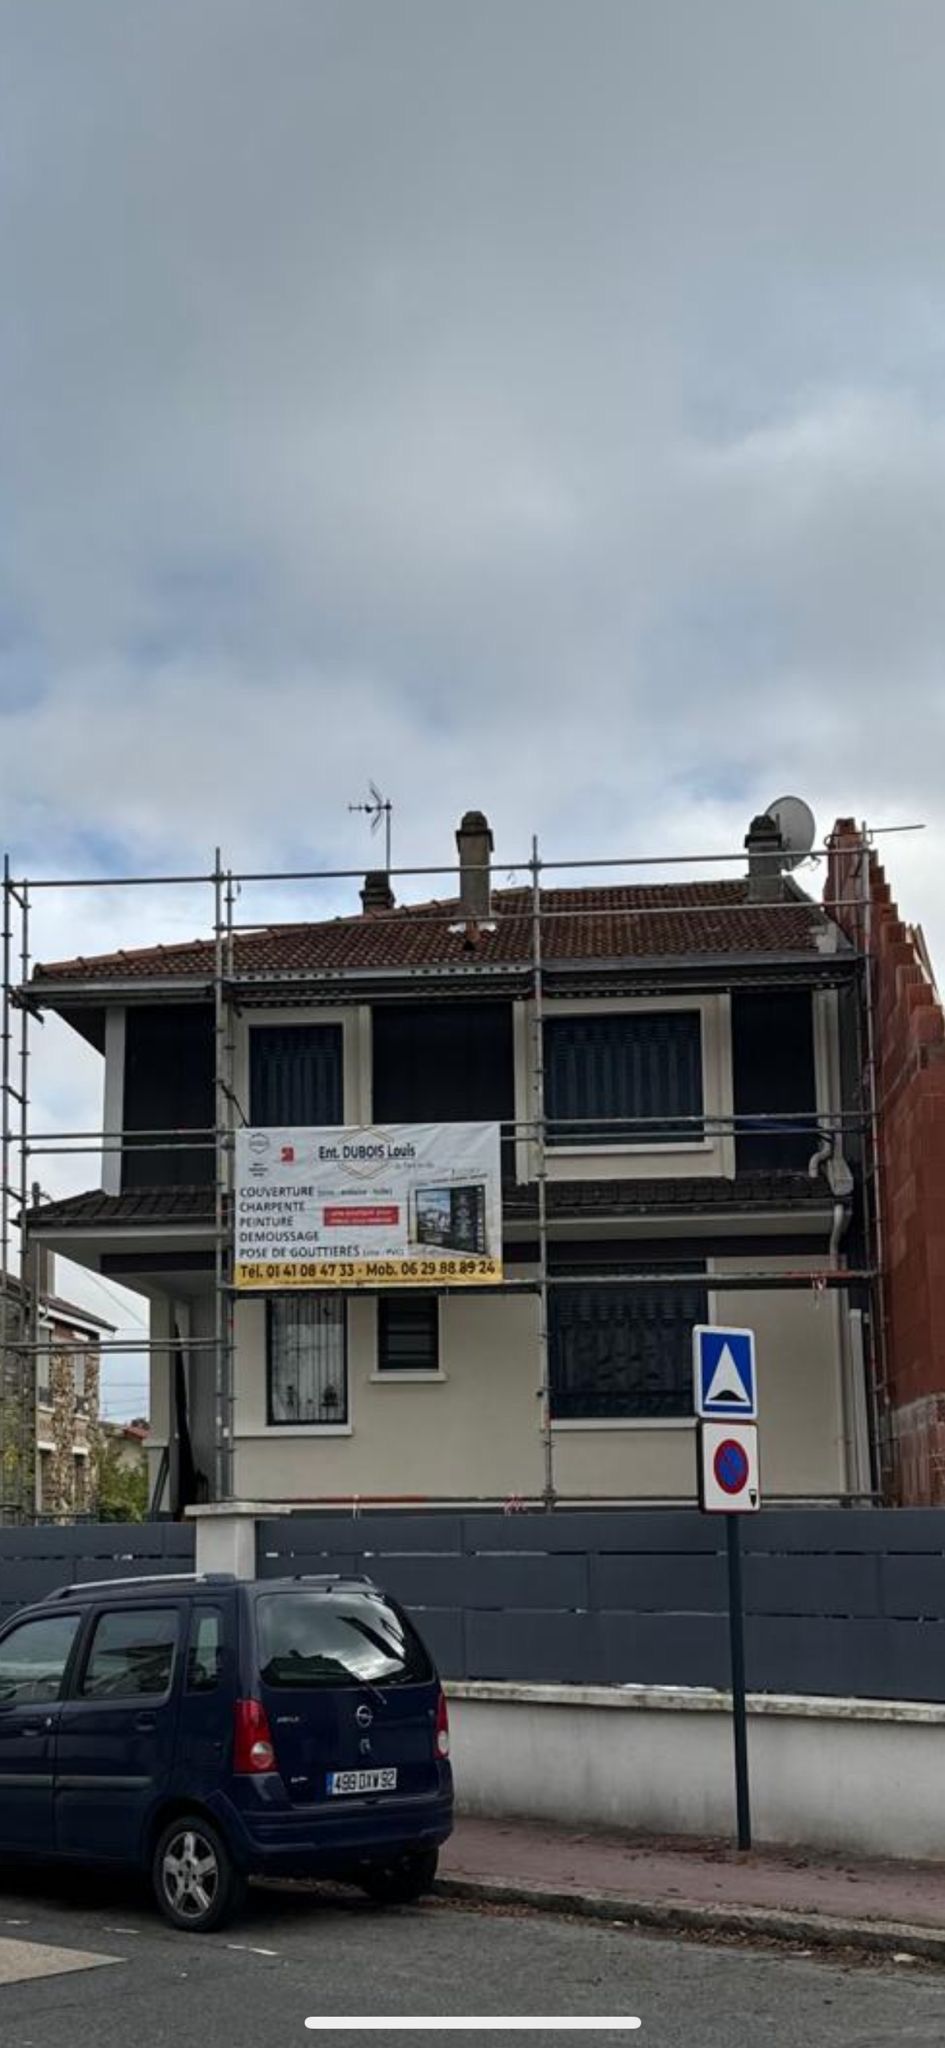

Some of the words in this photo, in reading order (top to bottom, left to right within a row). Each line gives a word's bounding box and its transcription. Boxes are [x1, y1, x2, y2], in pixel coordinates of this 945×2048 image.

[318, 1146, 340, 1159] Ent.
[343, 1144, 385, 1158] DUBOIS
[388, 1142, 416, 1157] Louis
[240, 1186, 314, 1198] COUVERTURE
[240, 1201, 305, 1213] CHARPENTE
[240, 1216, 294, 1227] PEINTURE
[239, 1231, 319, 1242] DEMOUSSAGE
[239, 1248, 264, 1258] POSE
[272, 1248, 286, 1258] DE
[290, 1246, 360, 1258] GOUTTIERES
[240, 1264, 263, 1278] Tél.
[266, 1265, 281, 1277] 01
[283, 1264, 298, 1277] 41
[300, 1264, 316, 1276] 08
[320, 1264, 336, 1276] 47
[339, 1263, 354, 1275] 33
[366, 1263, 398, 1276] Mob.
[401, 1262, 418, 1275] 06
[421, 1262, 436, 1274] 29
[439, 1261, 456, 1274] 88
[479, 1260, 496, 1273] 24
[381, 1771, 394, 1788] 92
